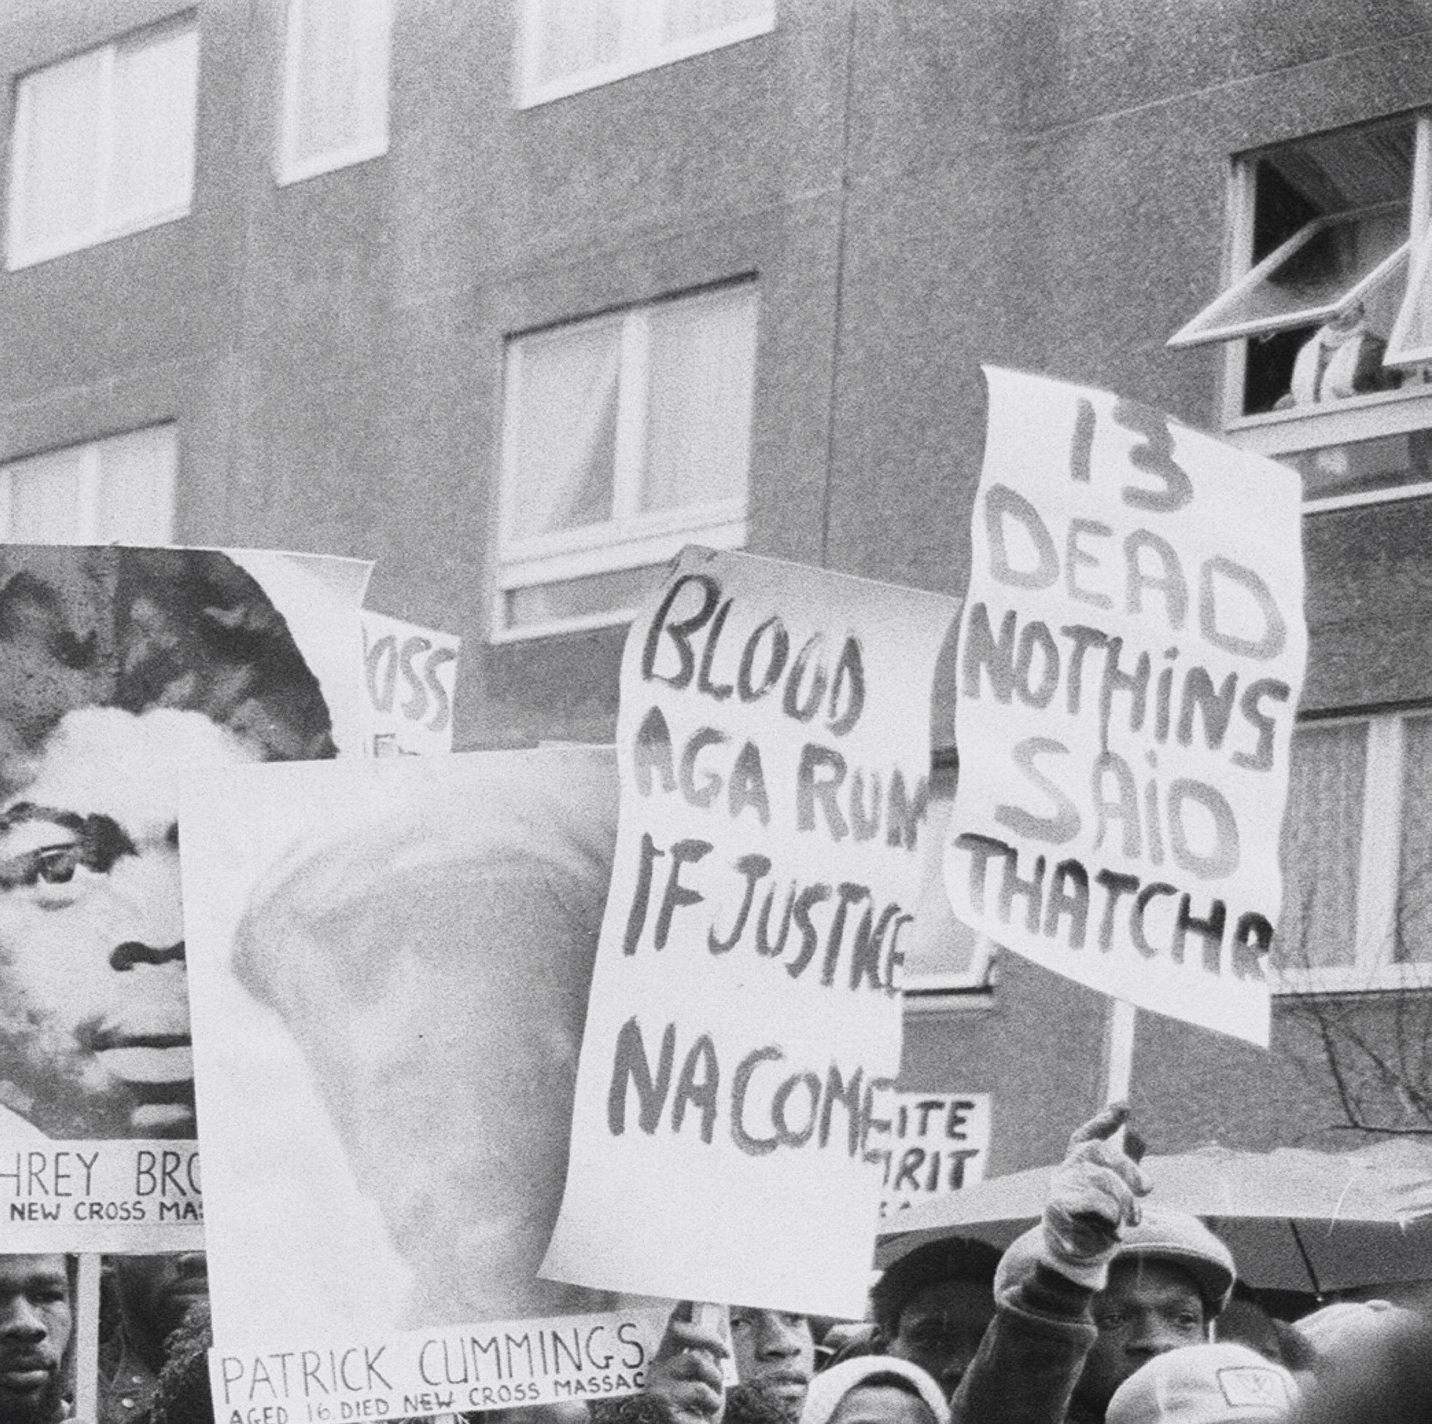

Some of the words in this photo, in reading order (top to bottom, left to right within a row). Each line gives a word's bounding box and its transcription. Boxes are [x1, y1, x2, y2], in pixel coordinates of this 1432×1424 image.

[1069, 396, 1195, 513] 13
[984, 482, 1288, 662] DEAD
[640, 573, 866, 737] BLOOD
[632, 705, 772, 828] AGA
[622, 832, 716, 958] IF
[607, 1013, 721, 1146] NA
[9, 1202, 60, 1222] NEW
[73, 1200, 147, 1222] CROSS
[222, 1345, 393, 1404] PATRICK
[340, 1398, 390, 1419] DIED
[403, 1391, 454, 1414] NEW
[468, 1381, 541, 1407] CROSS
[553, 1371, 646, 1397] MASSAC
